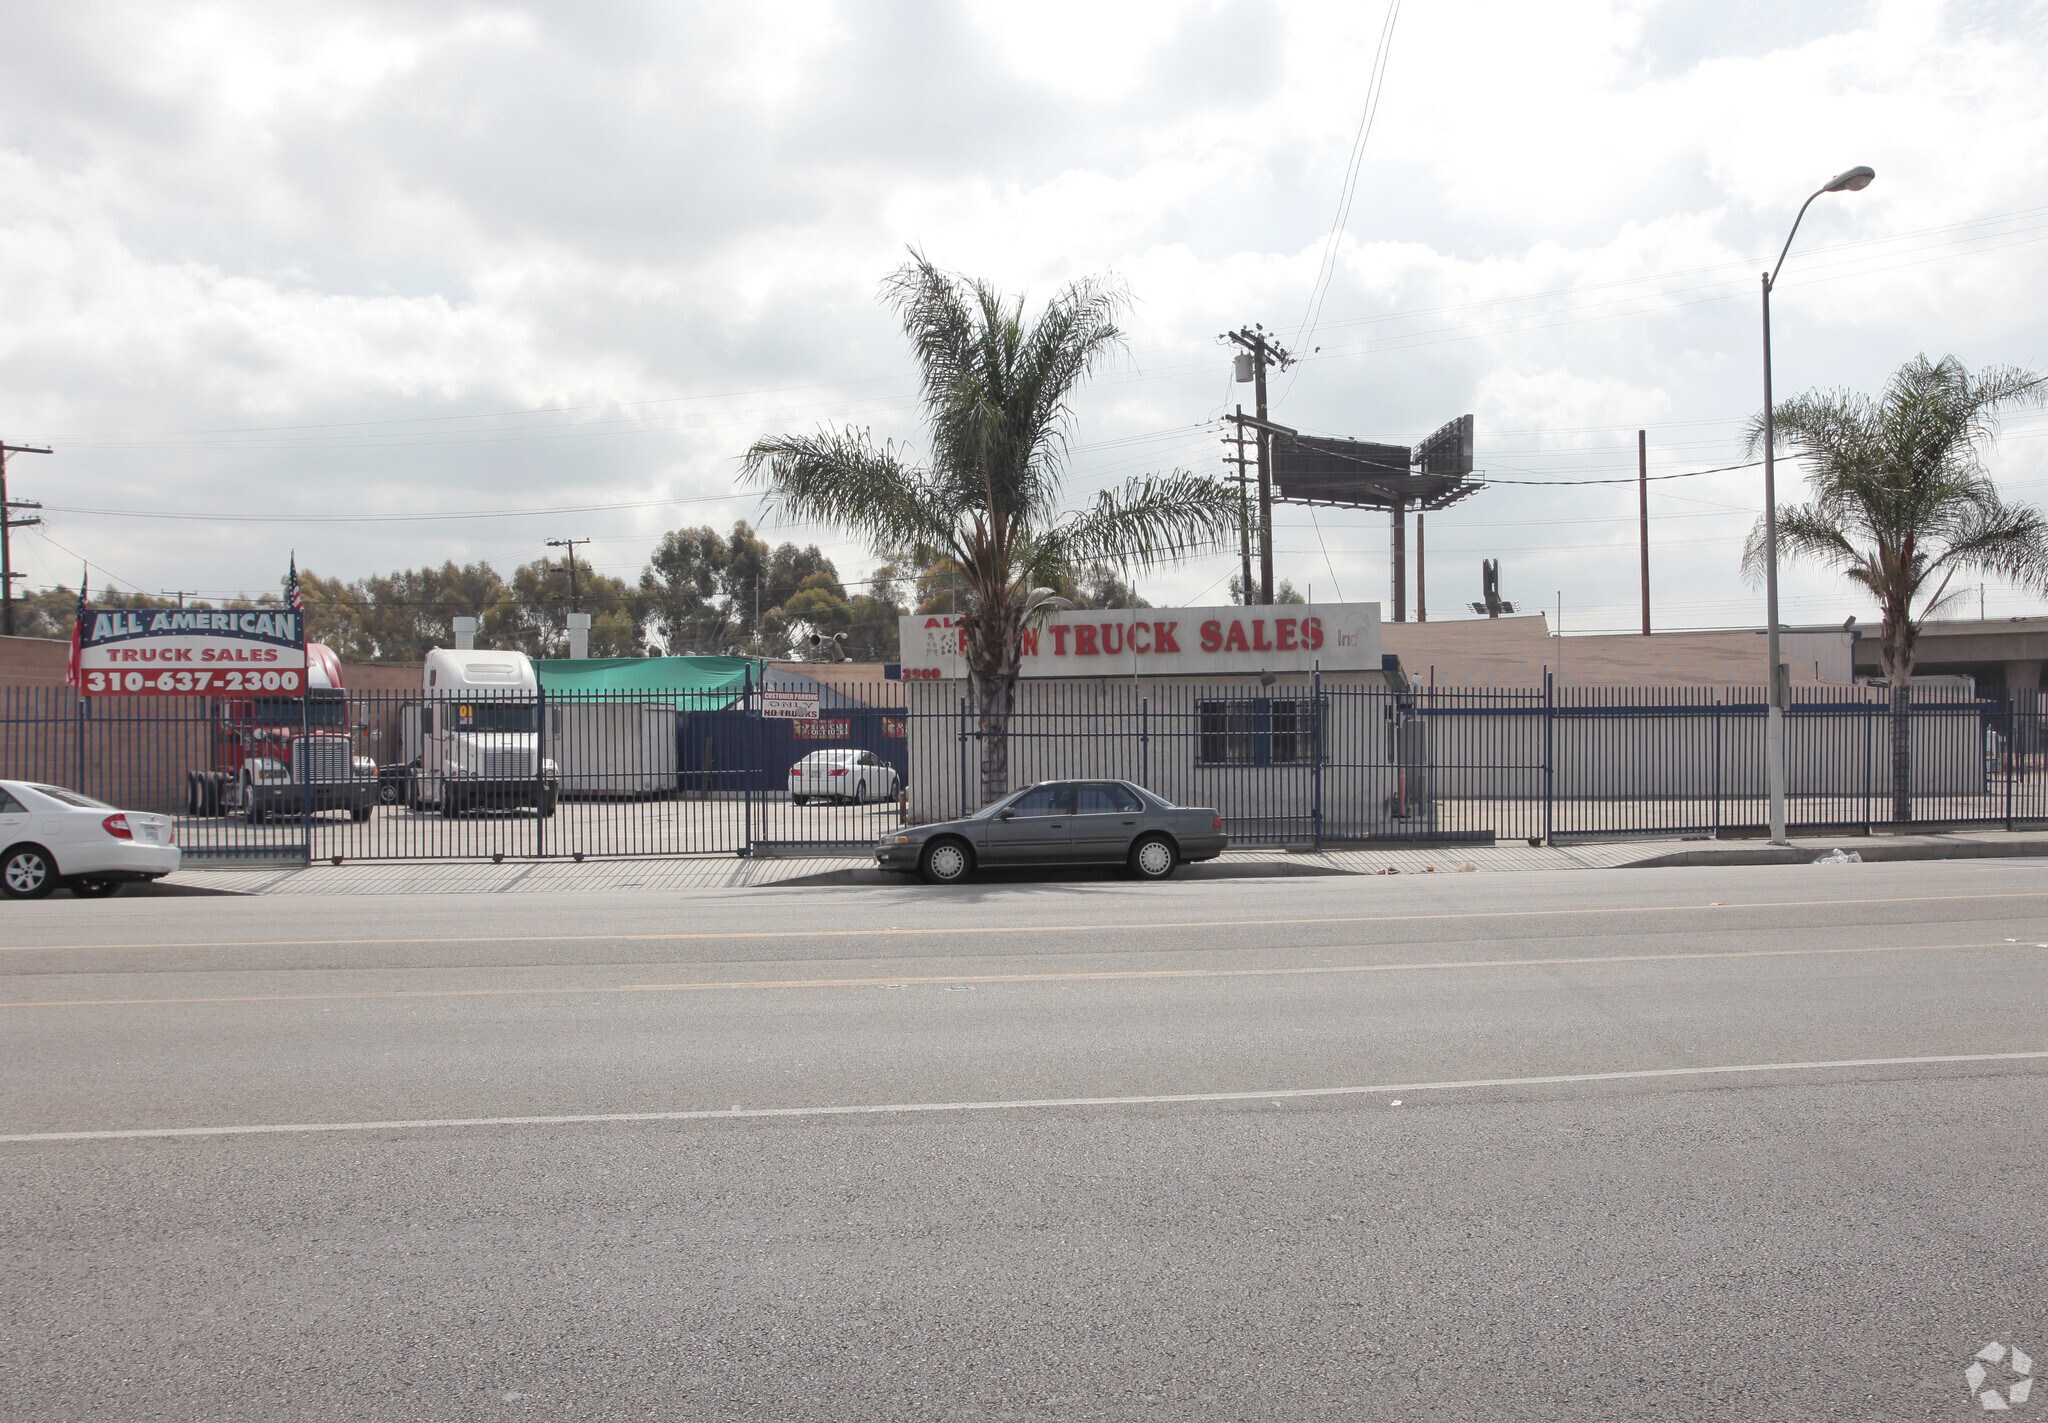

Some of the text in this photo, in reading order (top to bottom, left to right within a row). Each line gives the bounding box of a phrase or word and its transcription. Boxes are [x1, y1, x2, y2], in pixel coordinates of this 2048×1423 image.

[91, 612, 295, 641] ALL AMERICAN
[1048, 621, 1181, 656] TRUCK
[1200, 616, 1324, 653] SALES
[106, 648, 278, 662] TRUCK SALES
[87, 671, 299, 691] 310-637-2300
[764, 692, 818, 701] CUSTOMER PARKING
[764, 709, 818, 718] NO TRUKS
